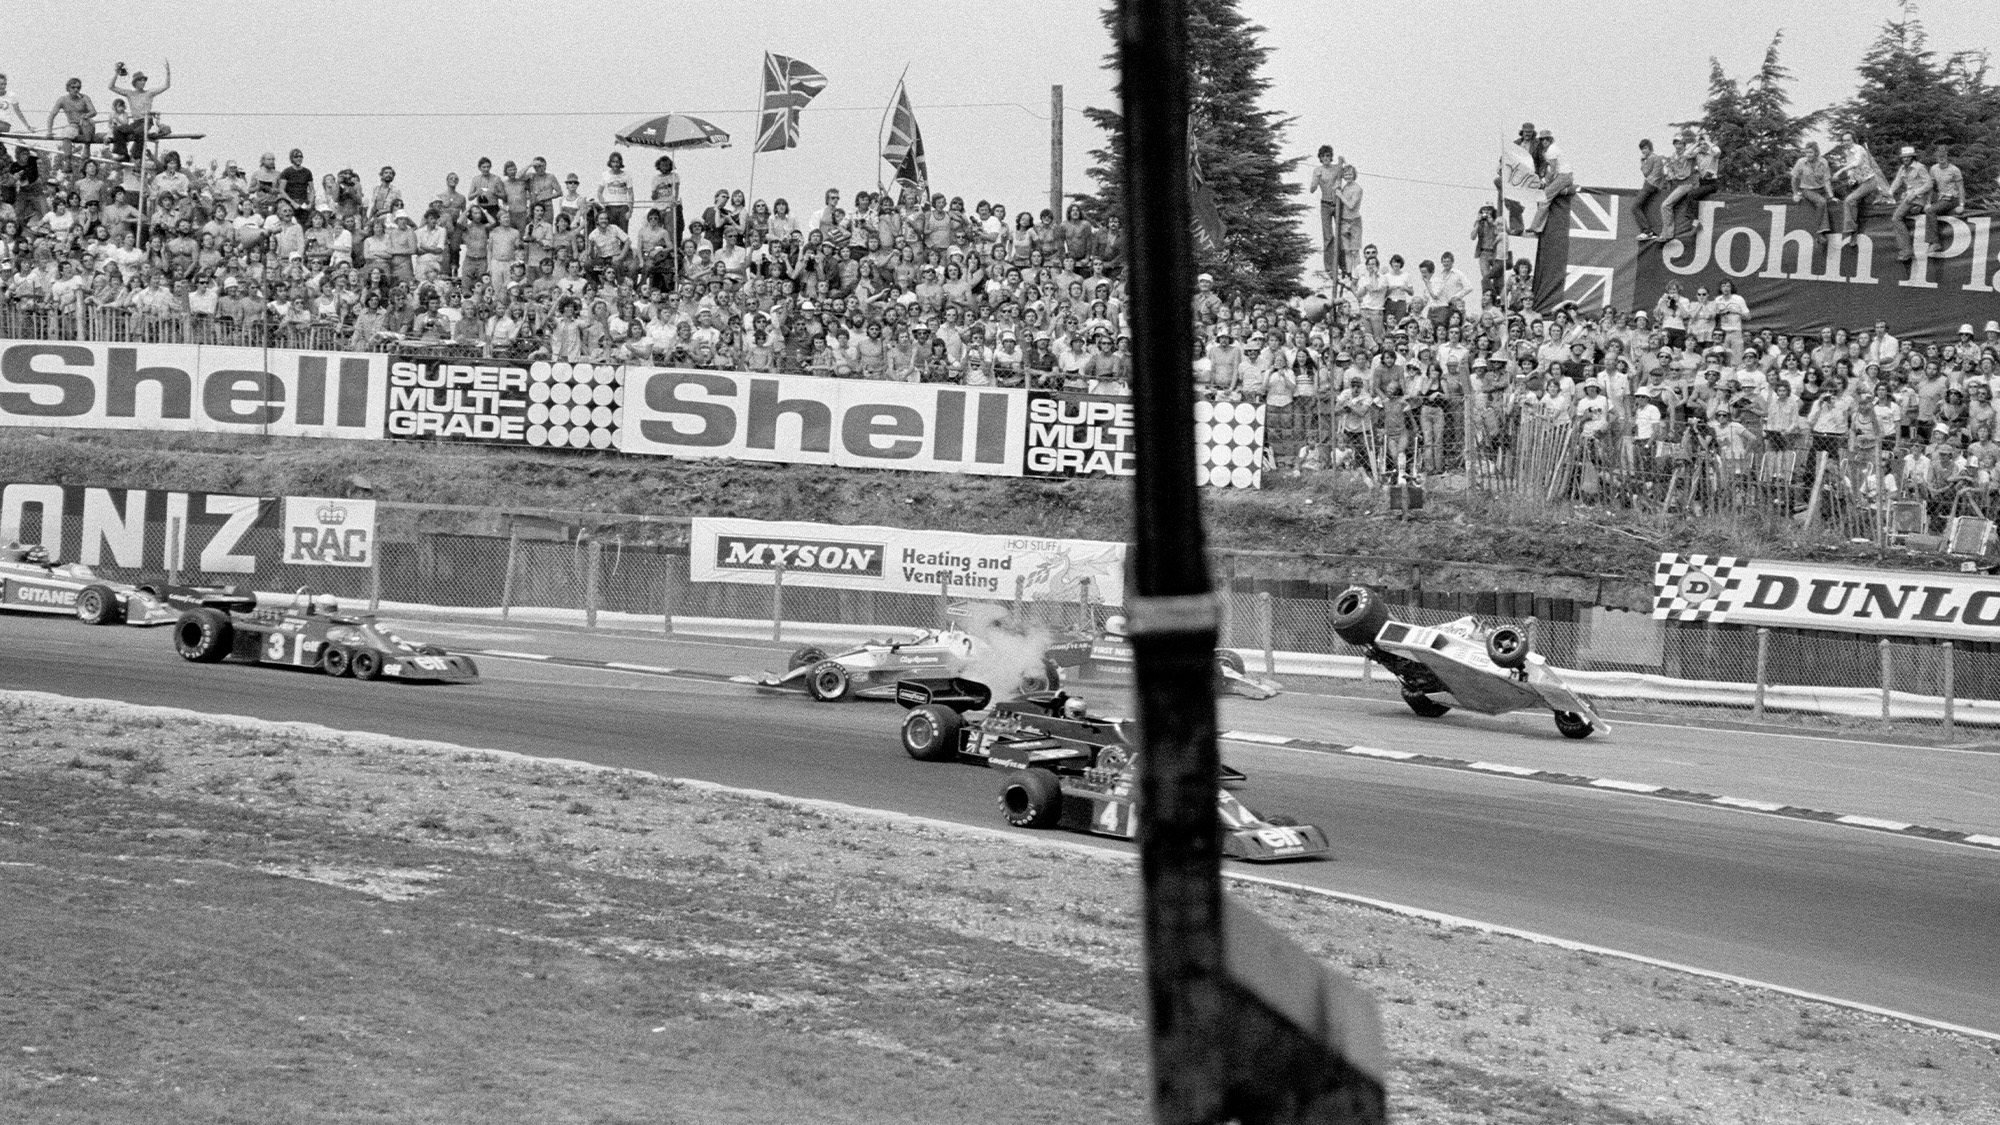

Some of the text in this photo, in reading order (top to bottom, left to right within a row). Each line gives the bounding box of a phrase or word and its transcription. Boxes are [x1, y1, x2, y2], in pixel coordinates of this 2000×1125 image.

[1189, 214, 1216, 251] UNT
[1662, 200, 1879, 285] John
[0, 343, 370, 428] Shell
[391, 362, 528, 392] SUPER
[389, 387, 527, 415] MULTI-
[1030, 398, 1136, 427] SUPE
[388, 410, 526, 440] GRADE
[640, 371, 1009, 465] Shell
[1028, 422, 1135, 451] MULT
[1027, 446, 1137, 476] GRAD
[2, 483, 261, 574] ONIZ
[291, 526, 367, 564] RAC
[725, 541, 875, 571] MYSON
[902, 547, 1012, 572] Heating and
[1007, 539, 1058, 551] HOT STUFF
[902, 566, 999, 592] Ventlating
[18, 586, 79, 606] GITANE
[1743, 573, 2000, 627] DUNLO
[267, 632, 285, 660] 3
[415, 655, 449, 671] elf
[1101, 800, 1119, 832] 4
[1257, 825, 1303, 848] elf
